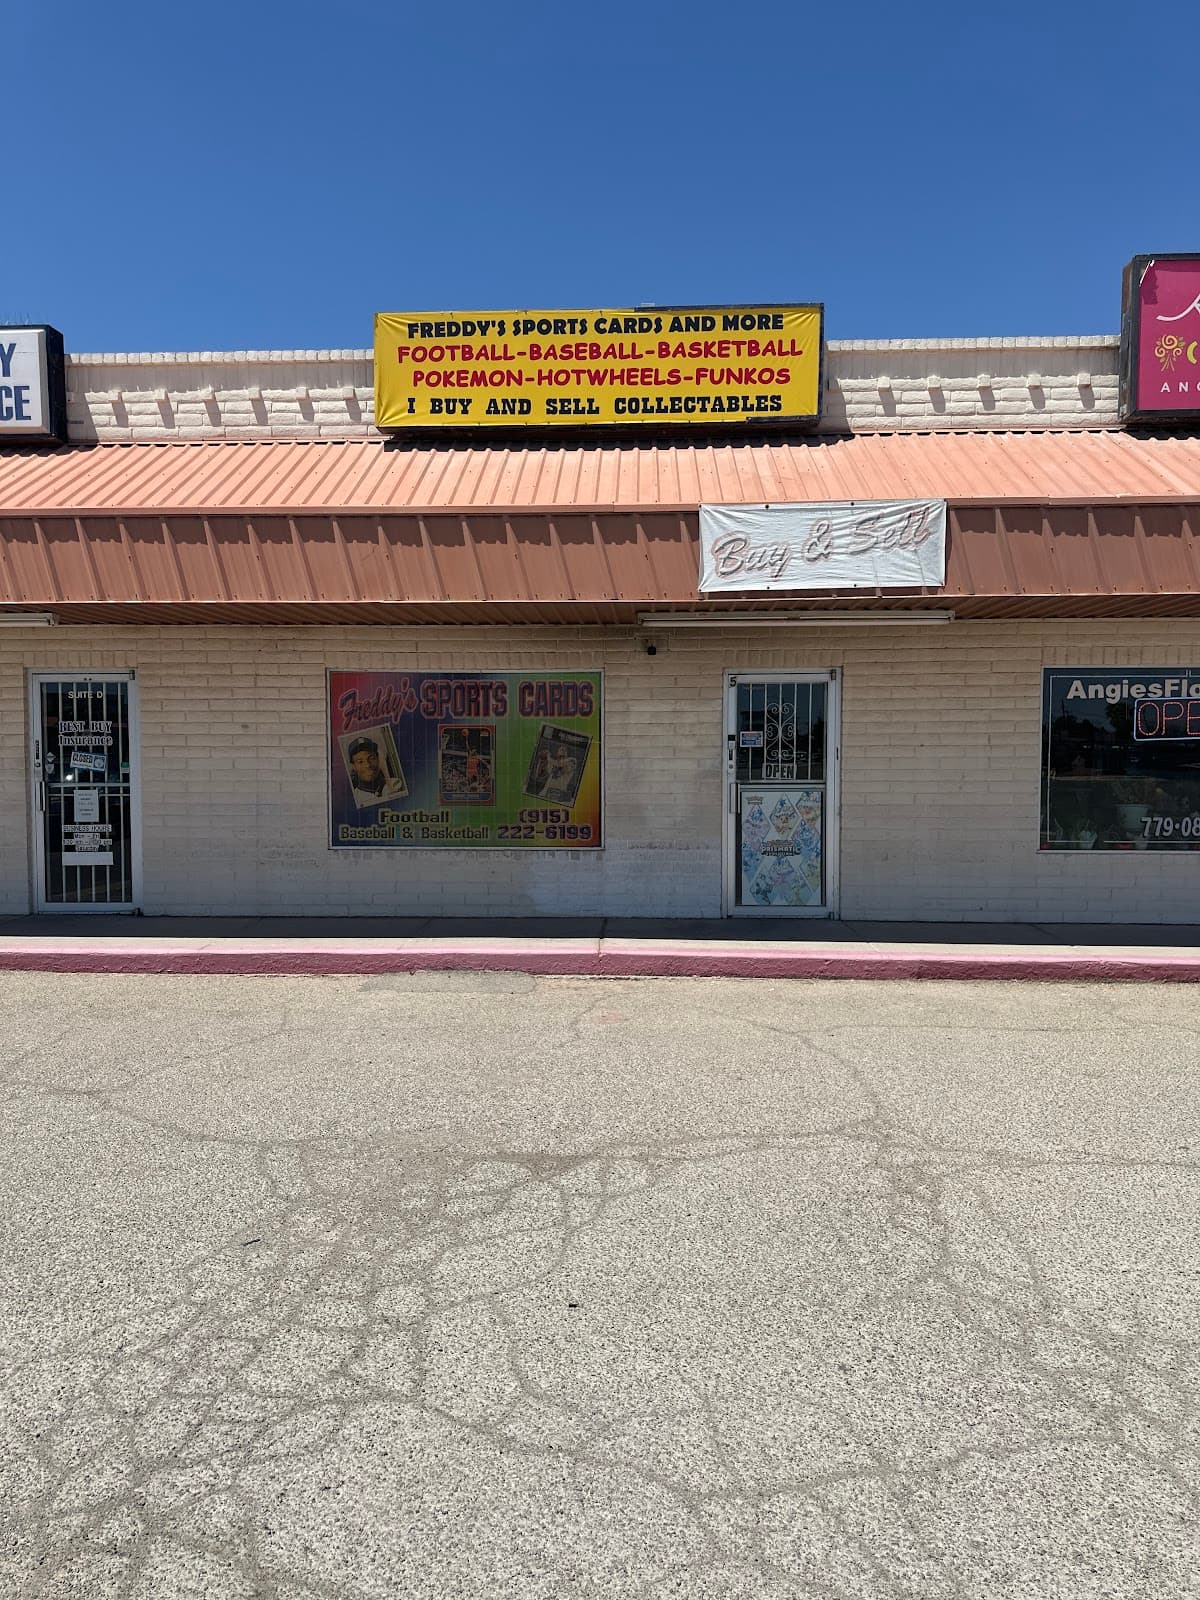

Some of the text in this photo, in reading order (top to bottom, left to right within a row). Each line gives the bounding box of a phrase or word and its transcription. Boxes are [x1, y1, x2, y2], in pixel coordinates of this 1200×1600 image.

[407, 314, 784, 338] FREDDY'S SPORTS CARDS AND MORE
[397, 339, 803, 363] FOOTBALL-BASEBALL-BASKETBALL
[413, 368, 791, 387] POKEMON-HOTWHEELS-FUNKOS
[407, 395, 782, 415] I BUY AND SELL COLLECTABLES
[712, 507, 930, 579] Buy & Sell
[729, 676, 737, 688] 5
[67, 690, 103, 699] SUITE D
[339, 676, 594, 731] Freddy's SPORTS CARDS
[58, 720, 112, 733] BEST BUY
[58, 734, 113, 746] Insurance
[72, 752, 93, 763] CLOSED
[765, 764, 795, 779] OPEN
[378, 809, 450, 825] Football
[519, 809, 570, 824] (915)
[339, 824, 489, 841] Baseball & Basketball
[497, 824, 593, 841] 222-6199
